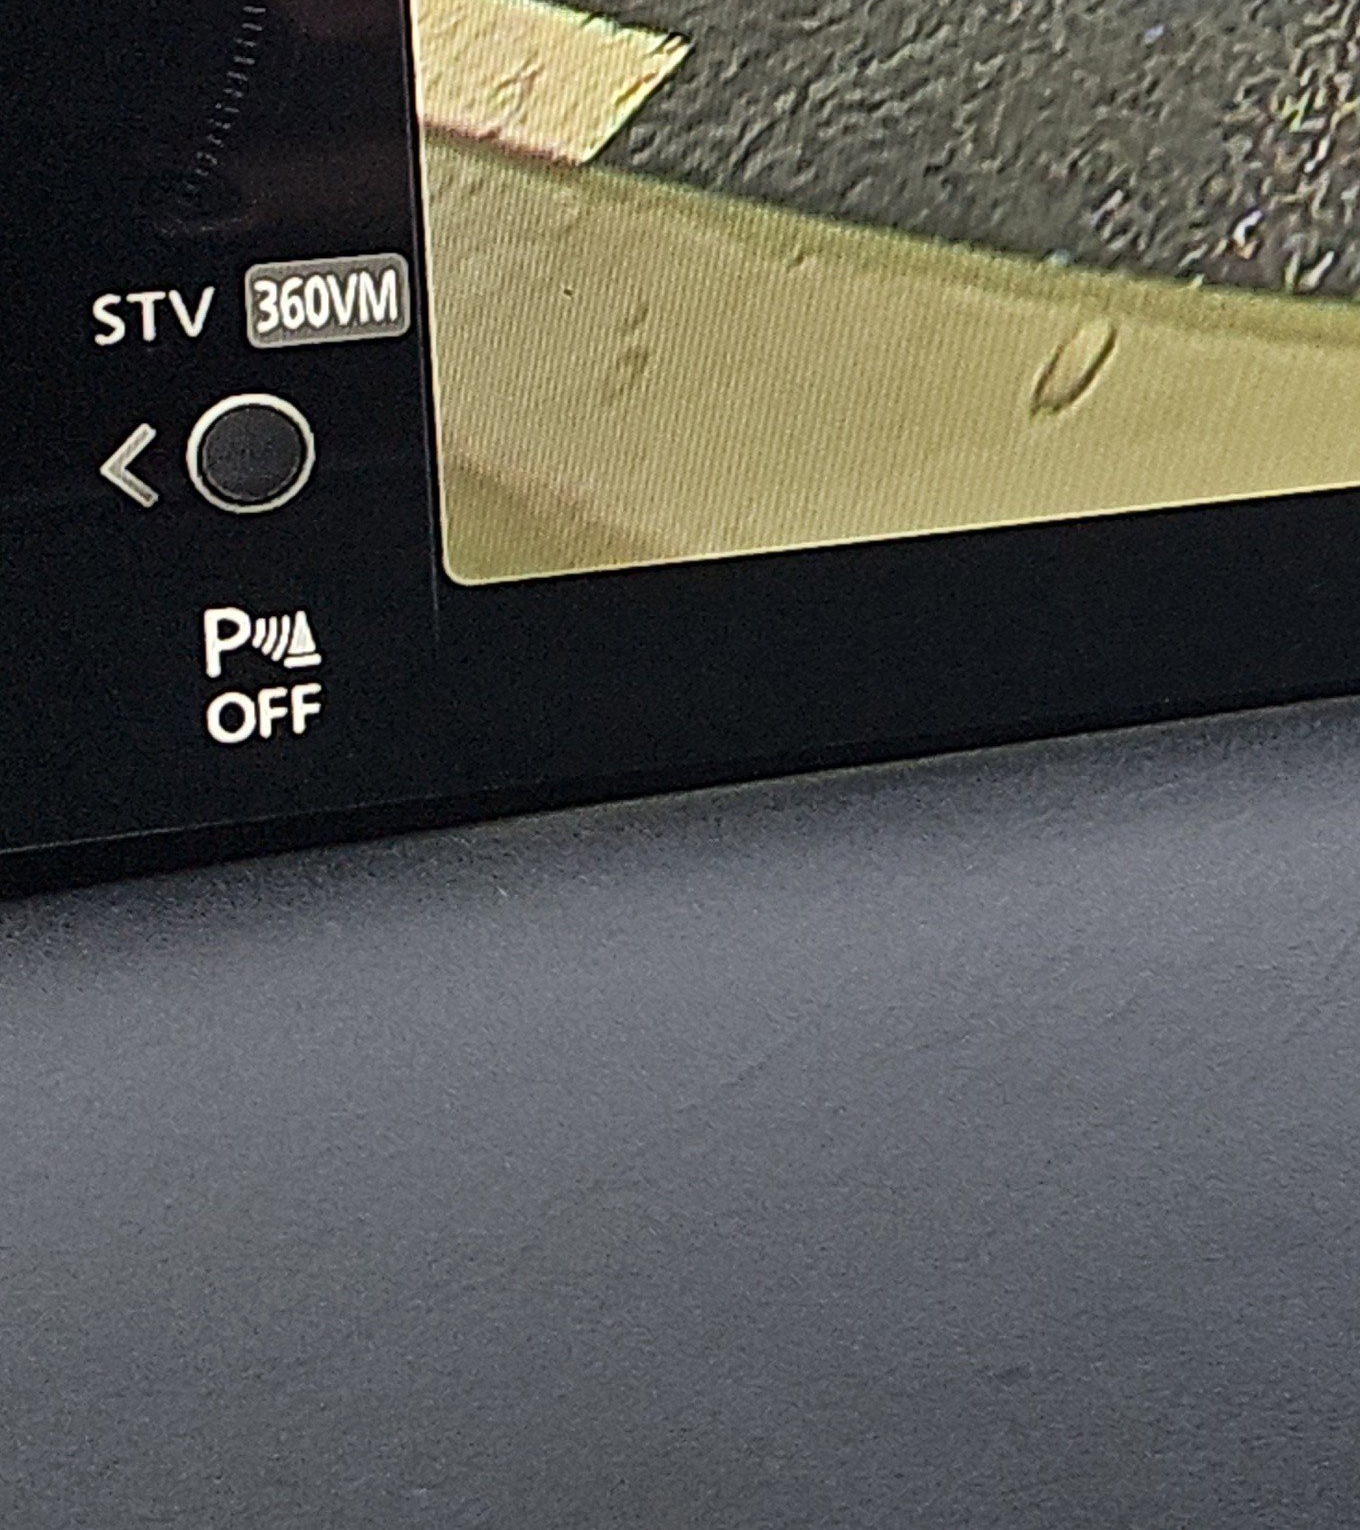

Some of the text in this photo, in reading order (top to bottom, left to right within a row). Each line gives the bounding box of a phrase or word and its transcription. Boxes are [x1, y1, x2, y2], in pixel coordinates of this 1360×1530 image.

[92, 285, 215, 346] STV
[253, 269, 399, 334] 360VM
[206, 681, 323, 744] OFF
